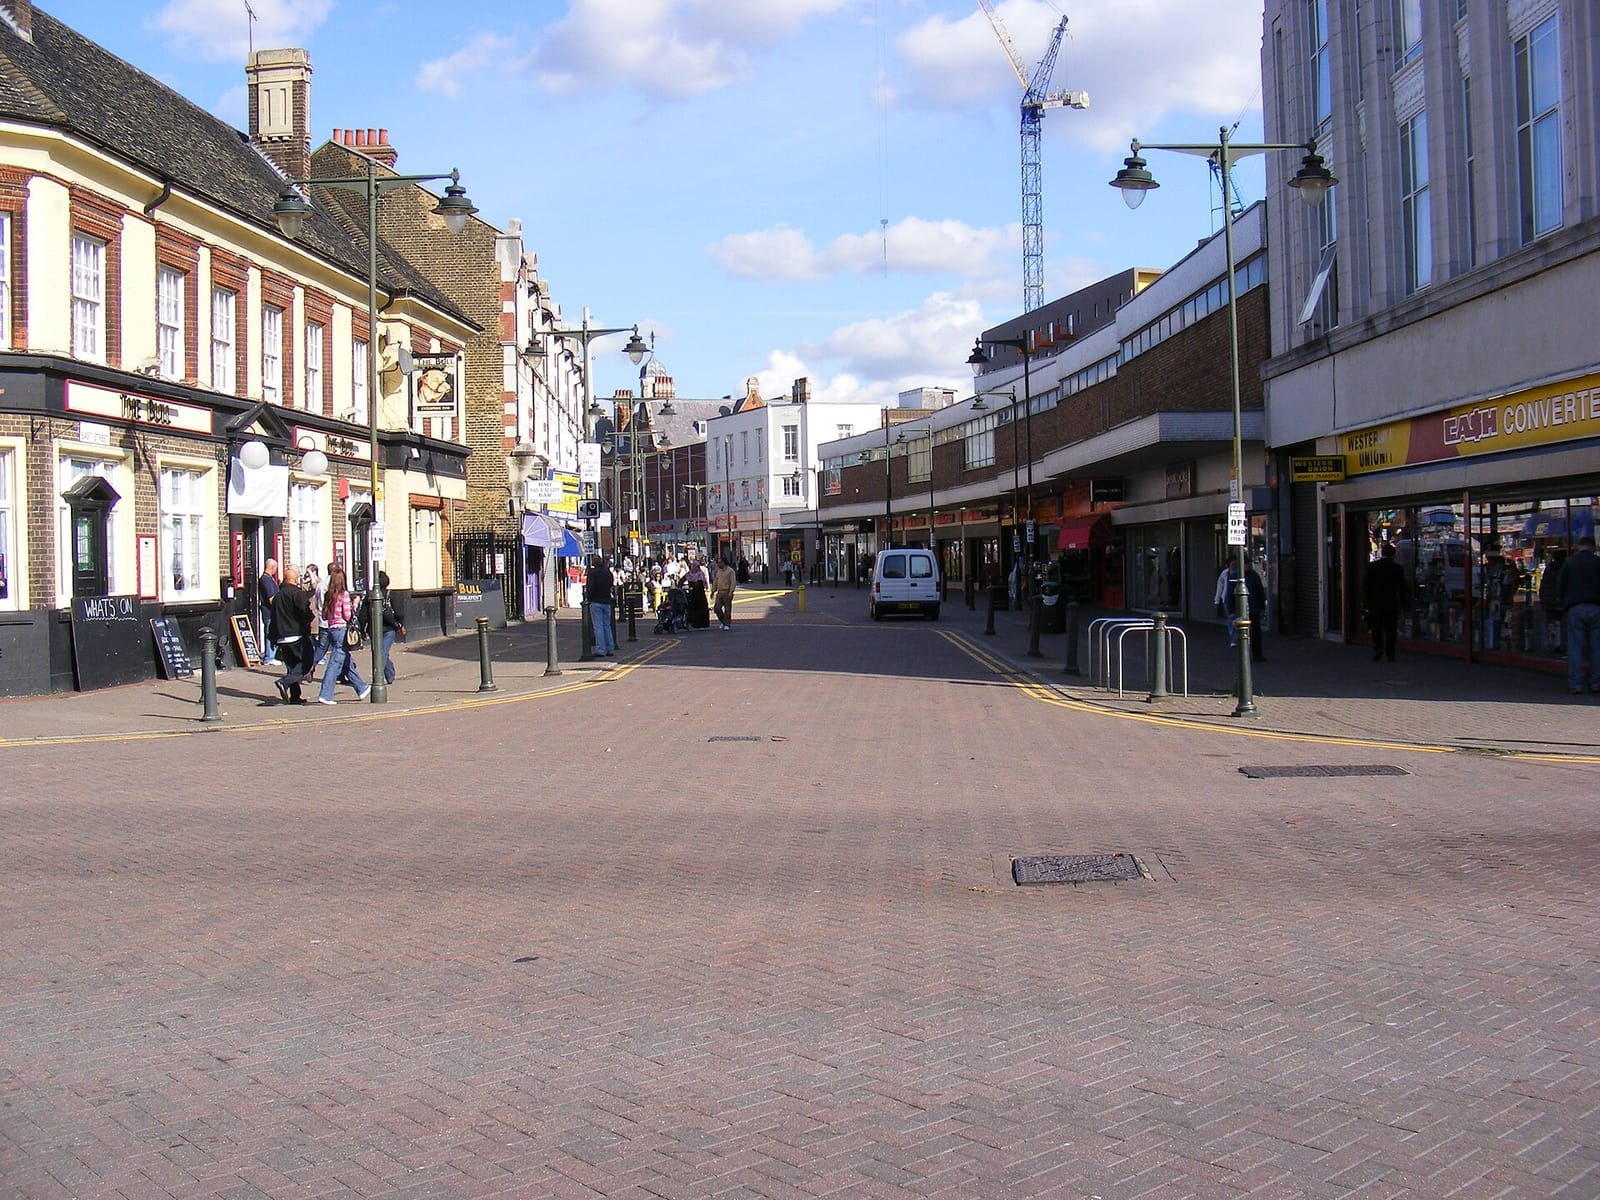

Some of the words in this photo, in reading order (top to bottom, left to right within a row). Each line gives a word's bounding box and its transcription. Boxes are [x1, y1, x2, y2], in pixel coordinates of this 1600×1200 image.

[436, 357, 453, 365] BULL
[120, 394, 141, 419] THE
[147, 400, 171, 425] BULL
[1503, 386, 1600, 435] CONVERTE
[1348, 430, 1386, 452] WESTER
[458, 583, 481, 594] BULL
[84, 598, 116, 618] WHATS
[120, 598, 133, 615] ON
